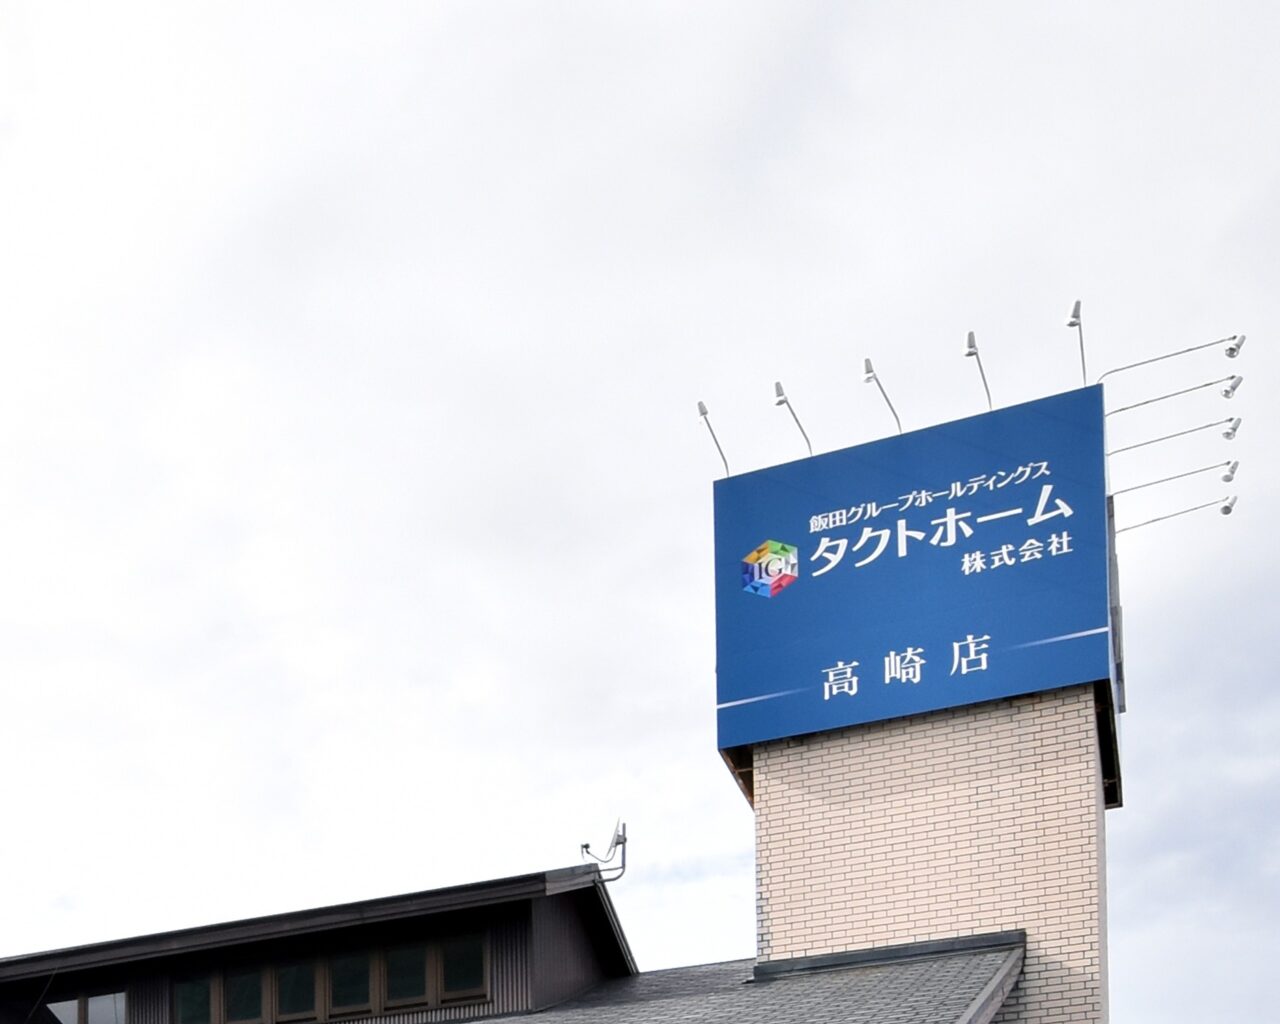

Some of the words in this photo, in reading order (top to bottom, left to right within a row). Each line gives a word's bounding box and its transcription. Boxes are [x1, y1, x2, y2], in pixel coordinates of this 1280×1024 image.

[808, 461, 1051, 533] 飯田グループホールディングス
[809, 484, 1074, 577] タクトホーム
[961, 531, 1074, 575] 株式会社
[822, 634, 991, 700] 高崎店
